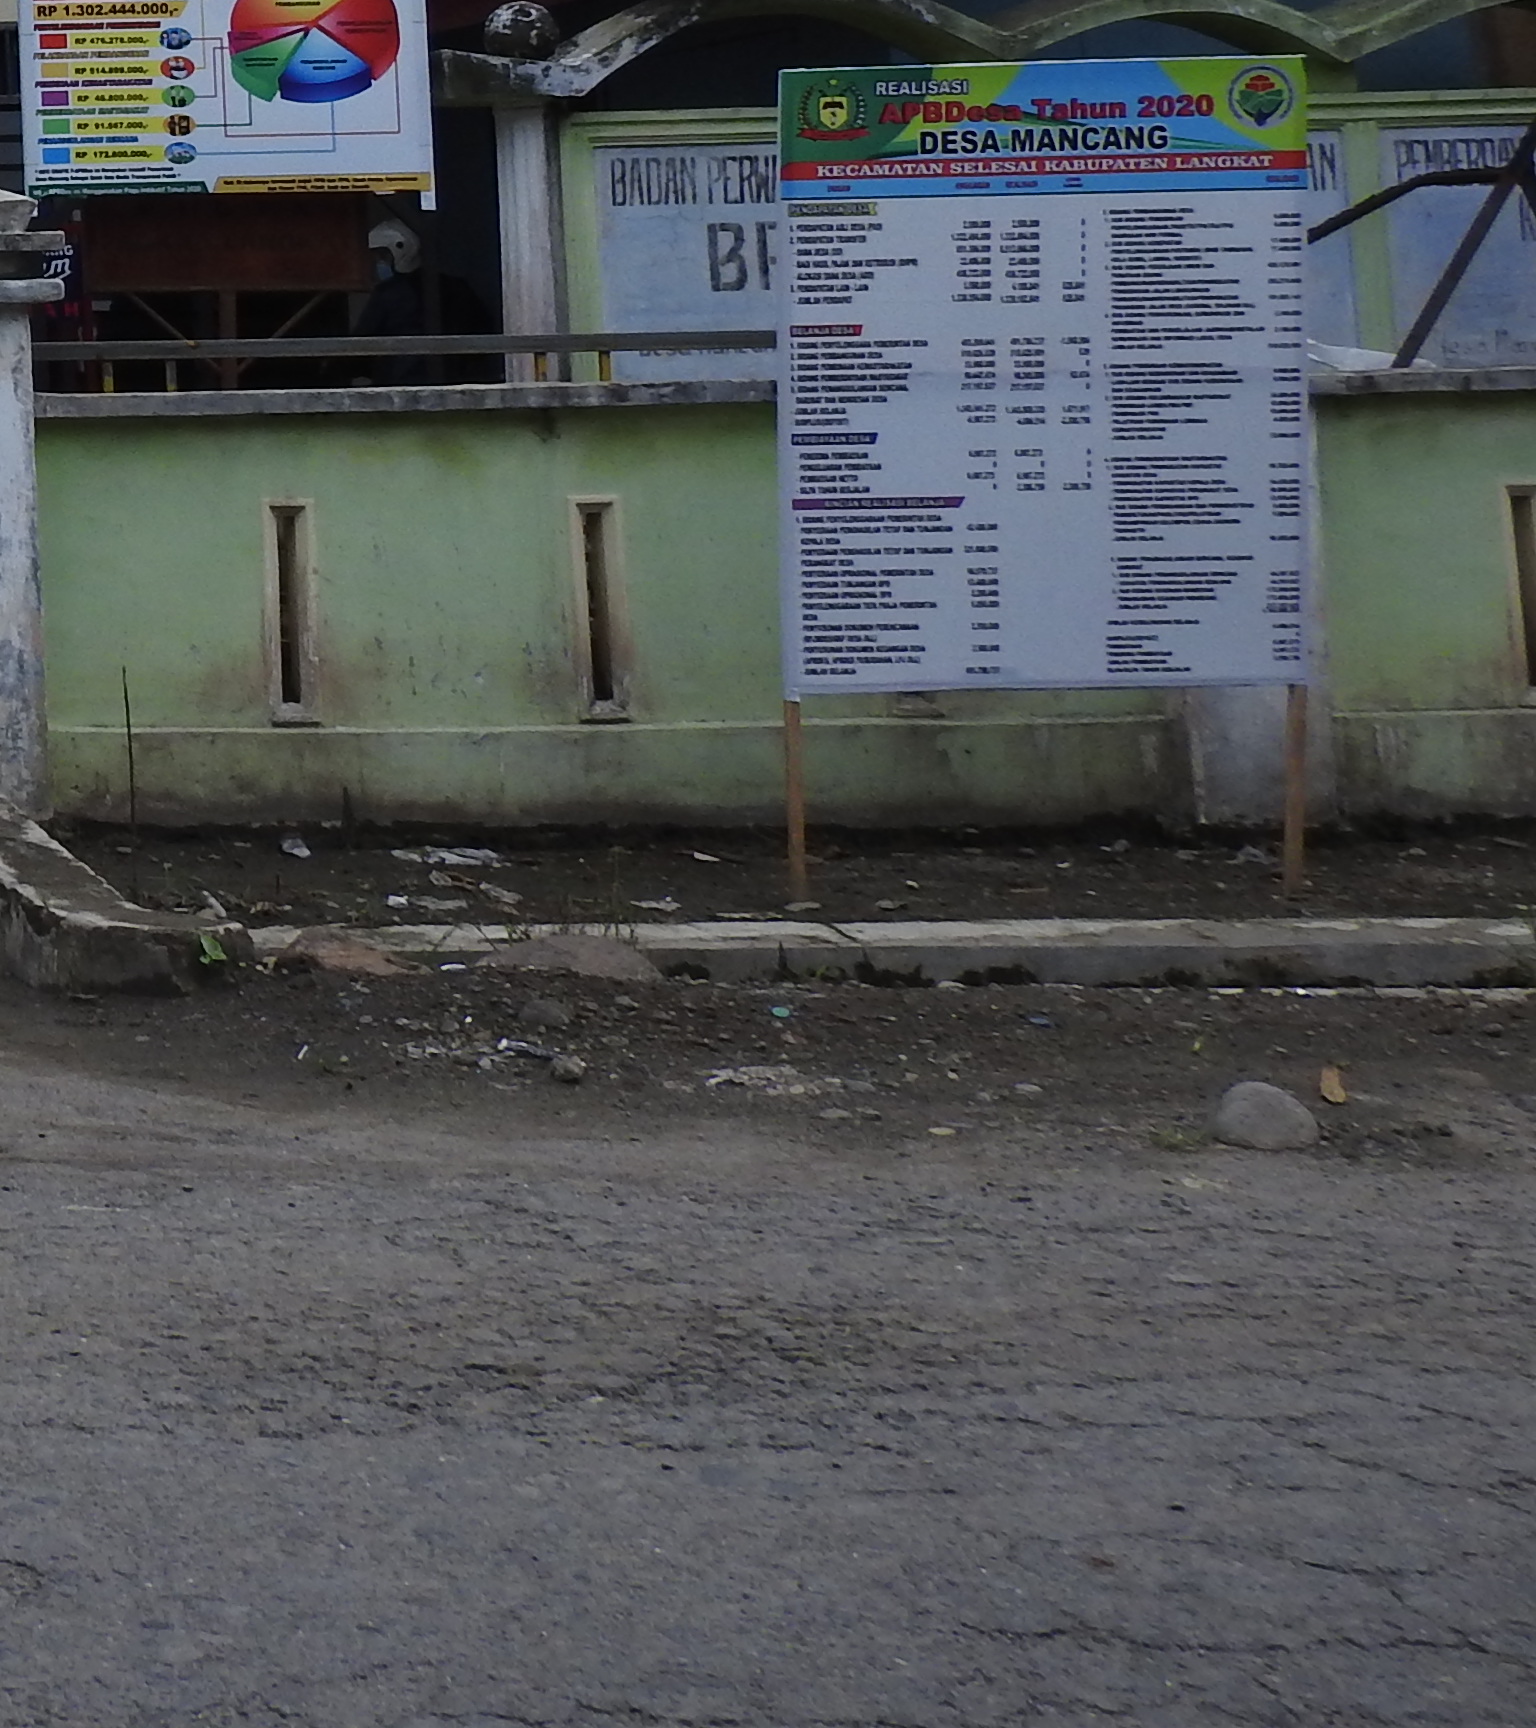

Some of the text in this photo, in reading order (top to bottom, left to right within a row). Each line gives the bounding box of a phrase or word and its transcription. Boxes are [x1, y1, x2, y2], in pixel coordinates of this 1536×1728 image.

[37, 2, 179, 18] RP 1.302.444.000,-
[876, 80, 969, 96] REALISASI
[879, 94, 1215, 124] APBDesa Tahun 2020
[919, 124, 1168, 155] DESA MANCANG
[816, 155, 1274, 178] KECAMATAN SELESAI KABUPATEN LANGKAT
[611, 155, 777, 206] BADAN PERW
